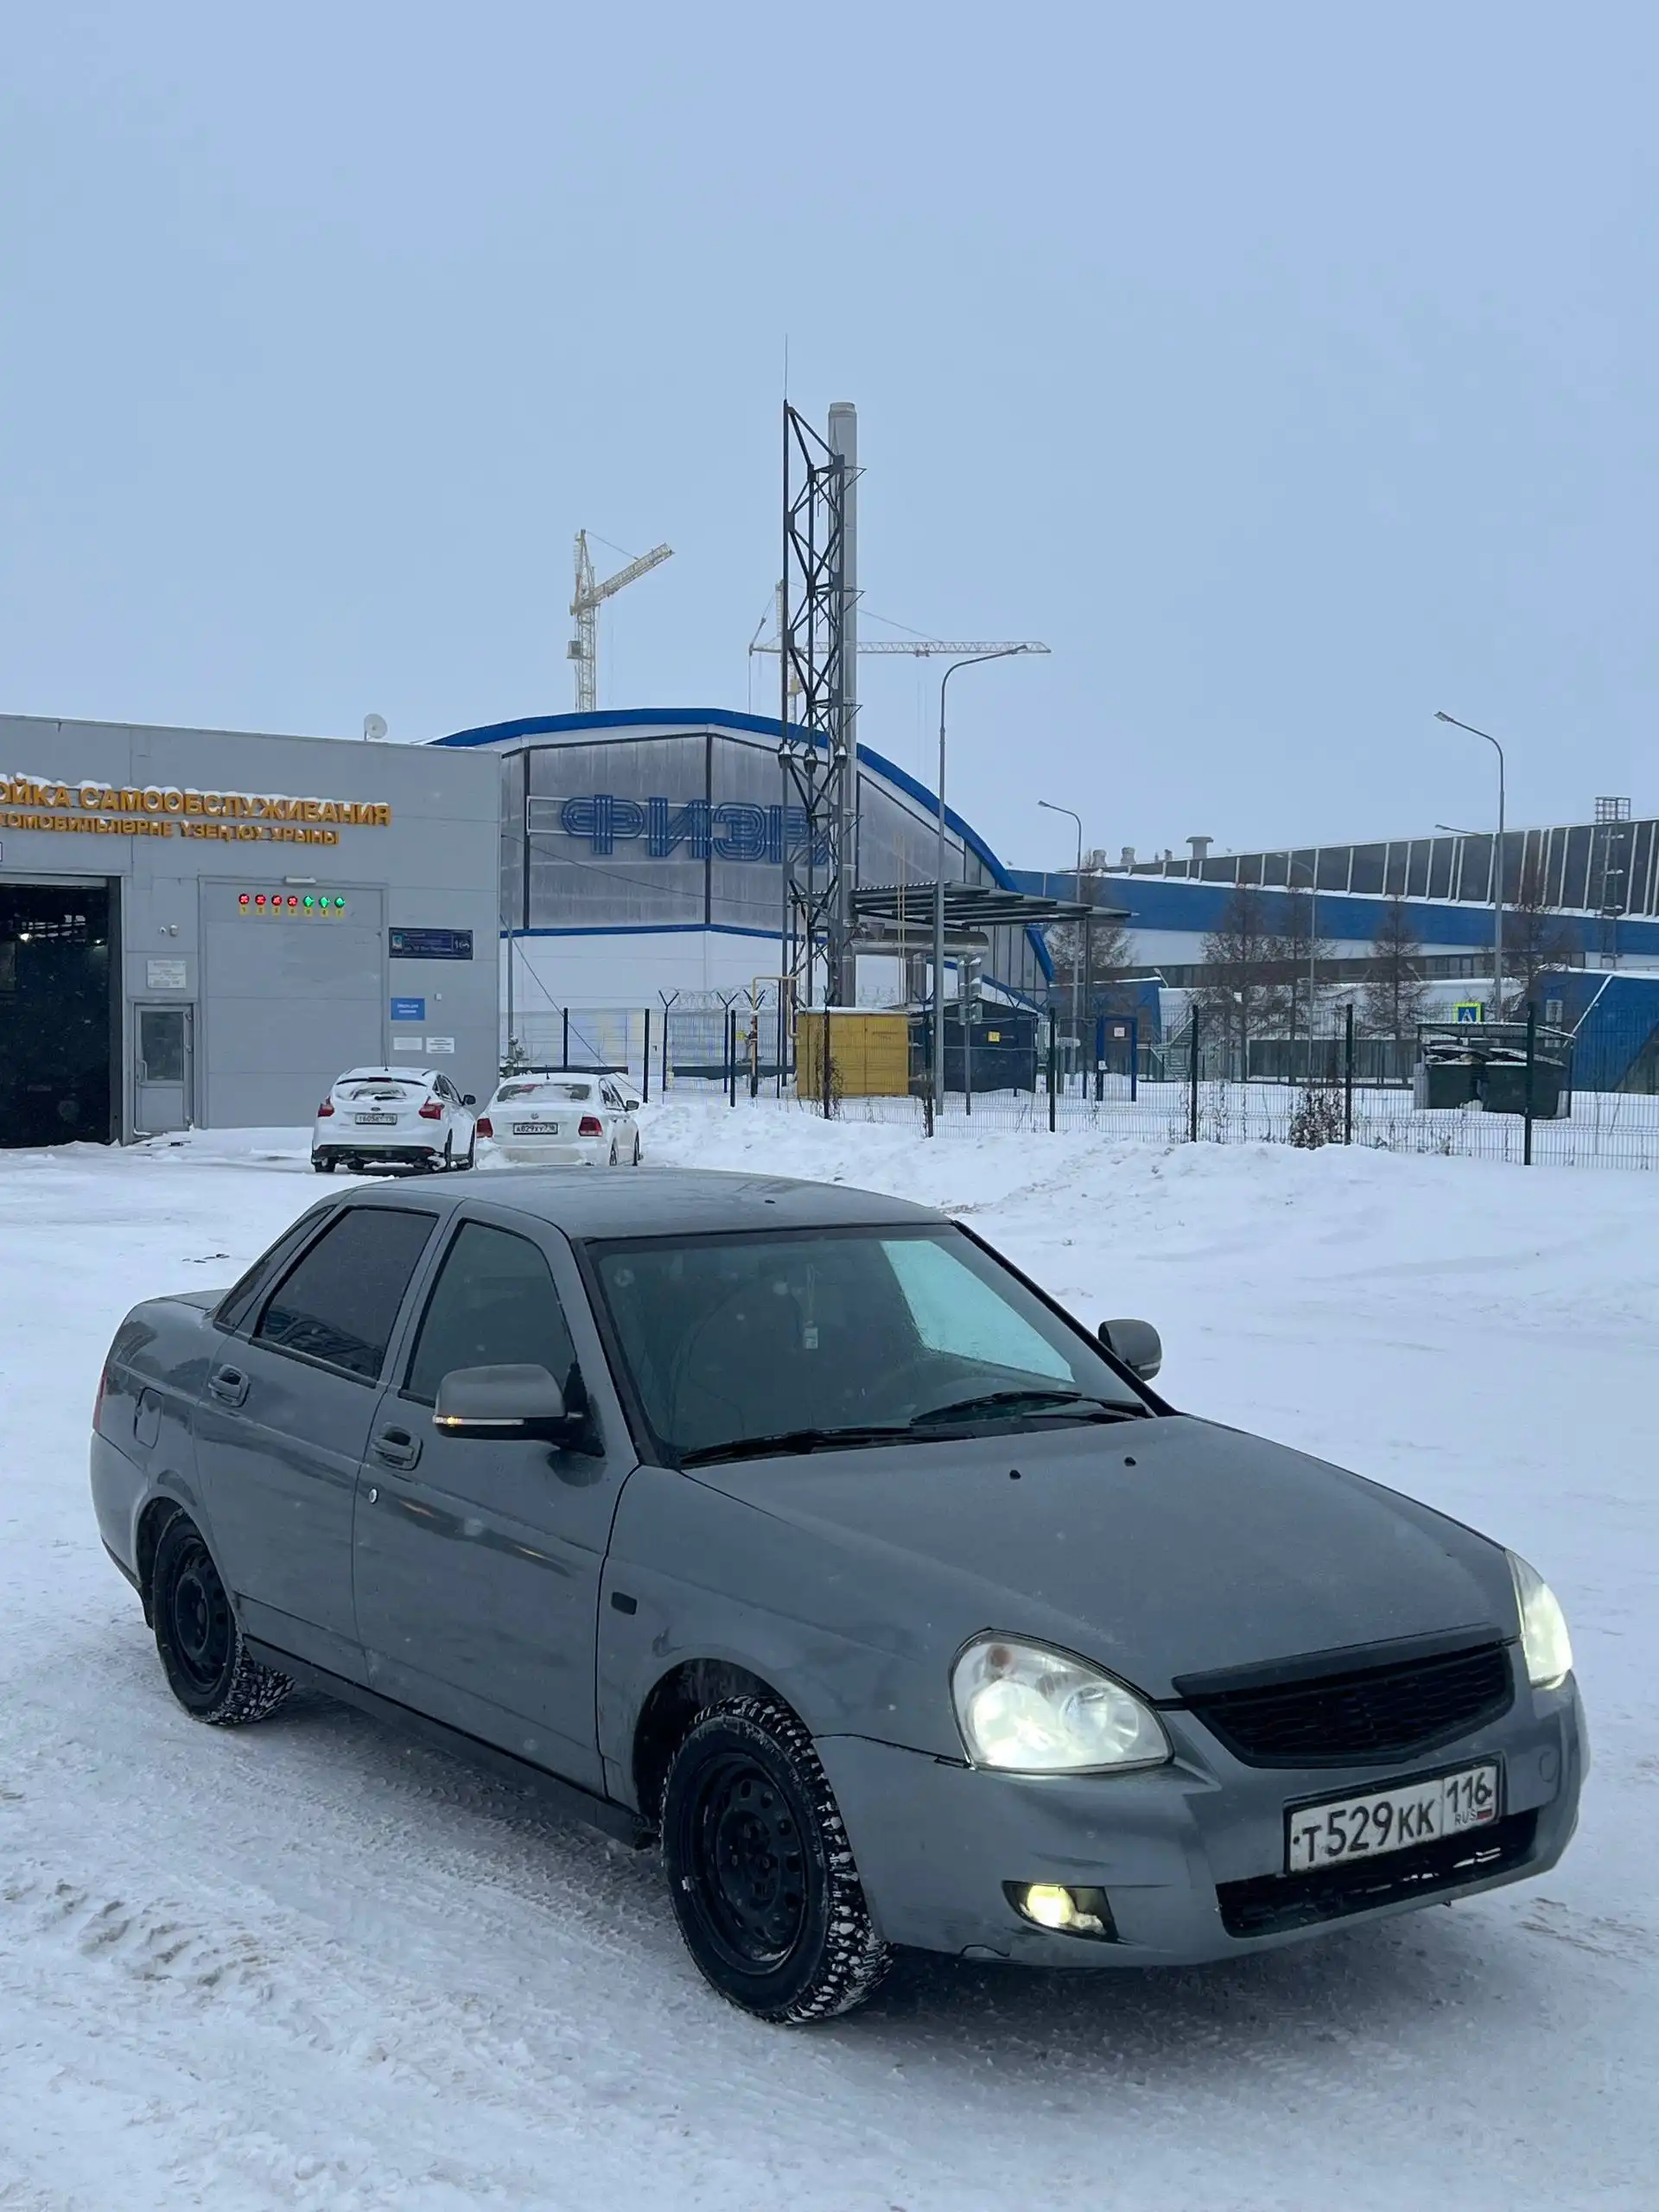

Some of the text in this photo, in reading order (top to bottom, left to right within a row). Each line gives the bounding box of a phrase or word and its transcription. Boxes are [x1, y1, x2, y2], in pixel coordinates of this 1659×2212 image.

[80, 787, 391, 826] САМООБСЛУЖИВАНИЯ
[1302, 1771, 1487, 1862] Т529КК 116
[1455, 1808, 1477, 1825] RUS
